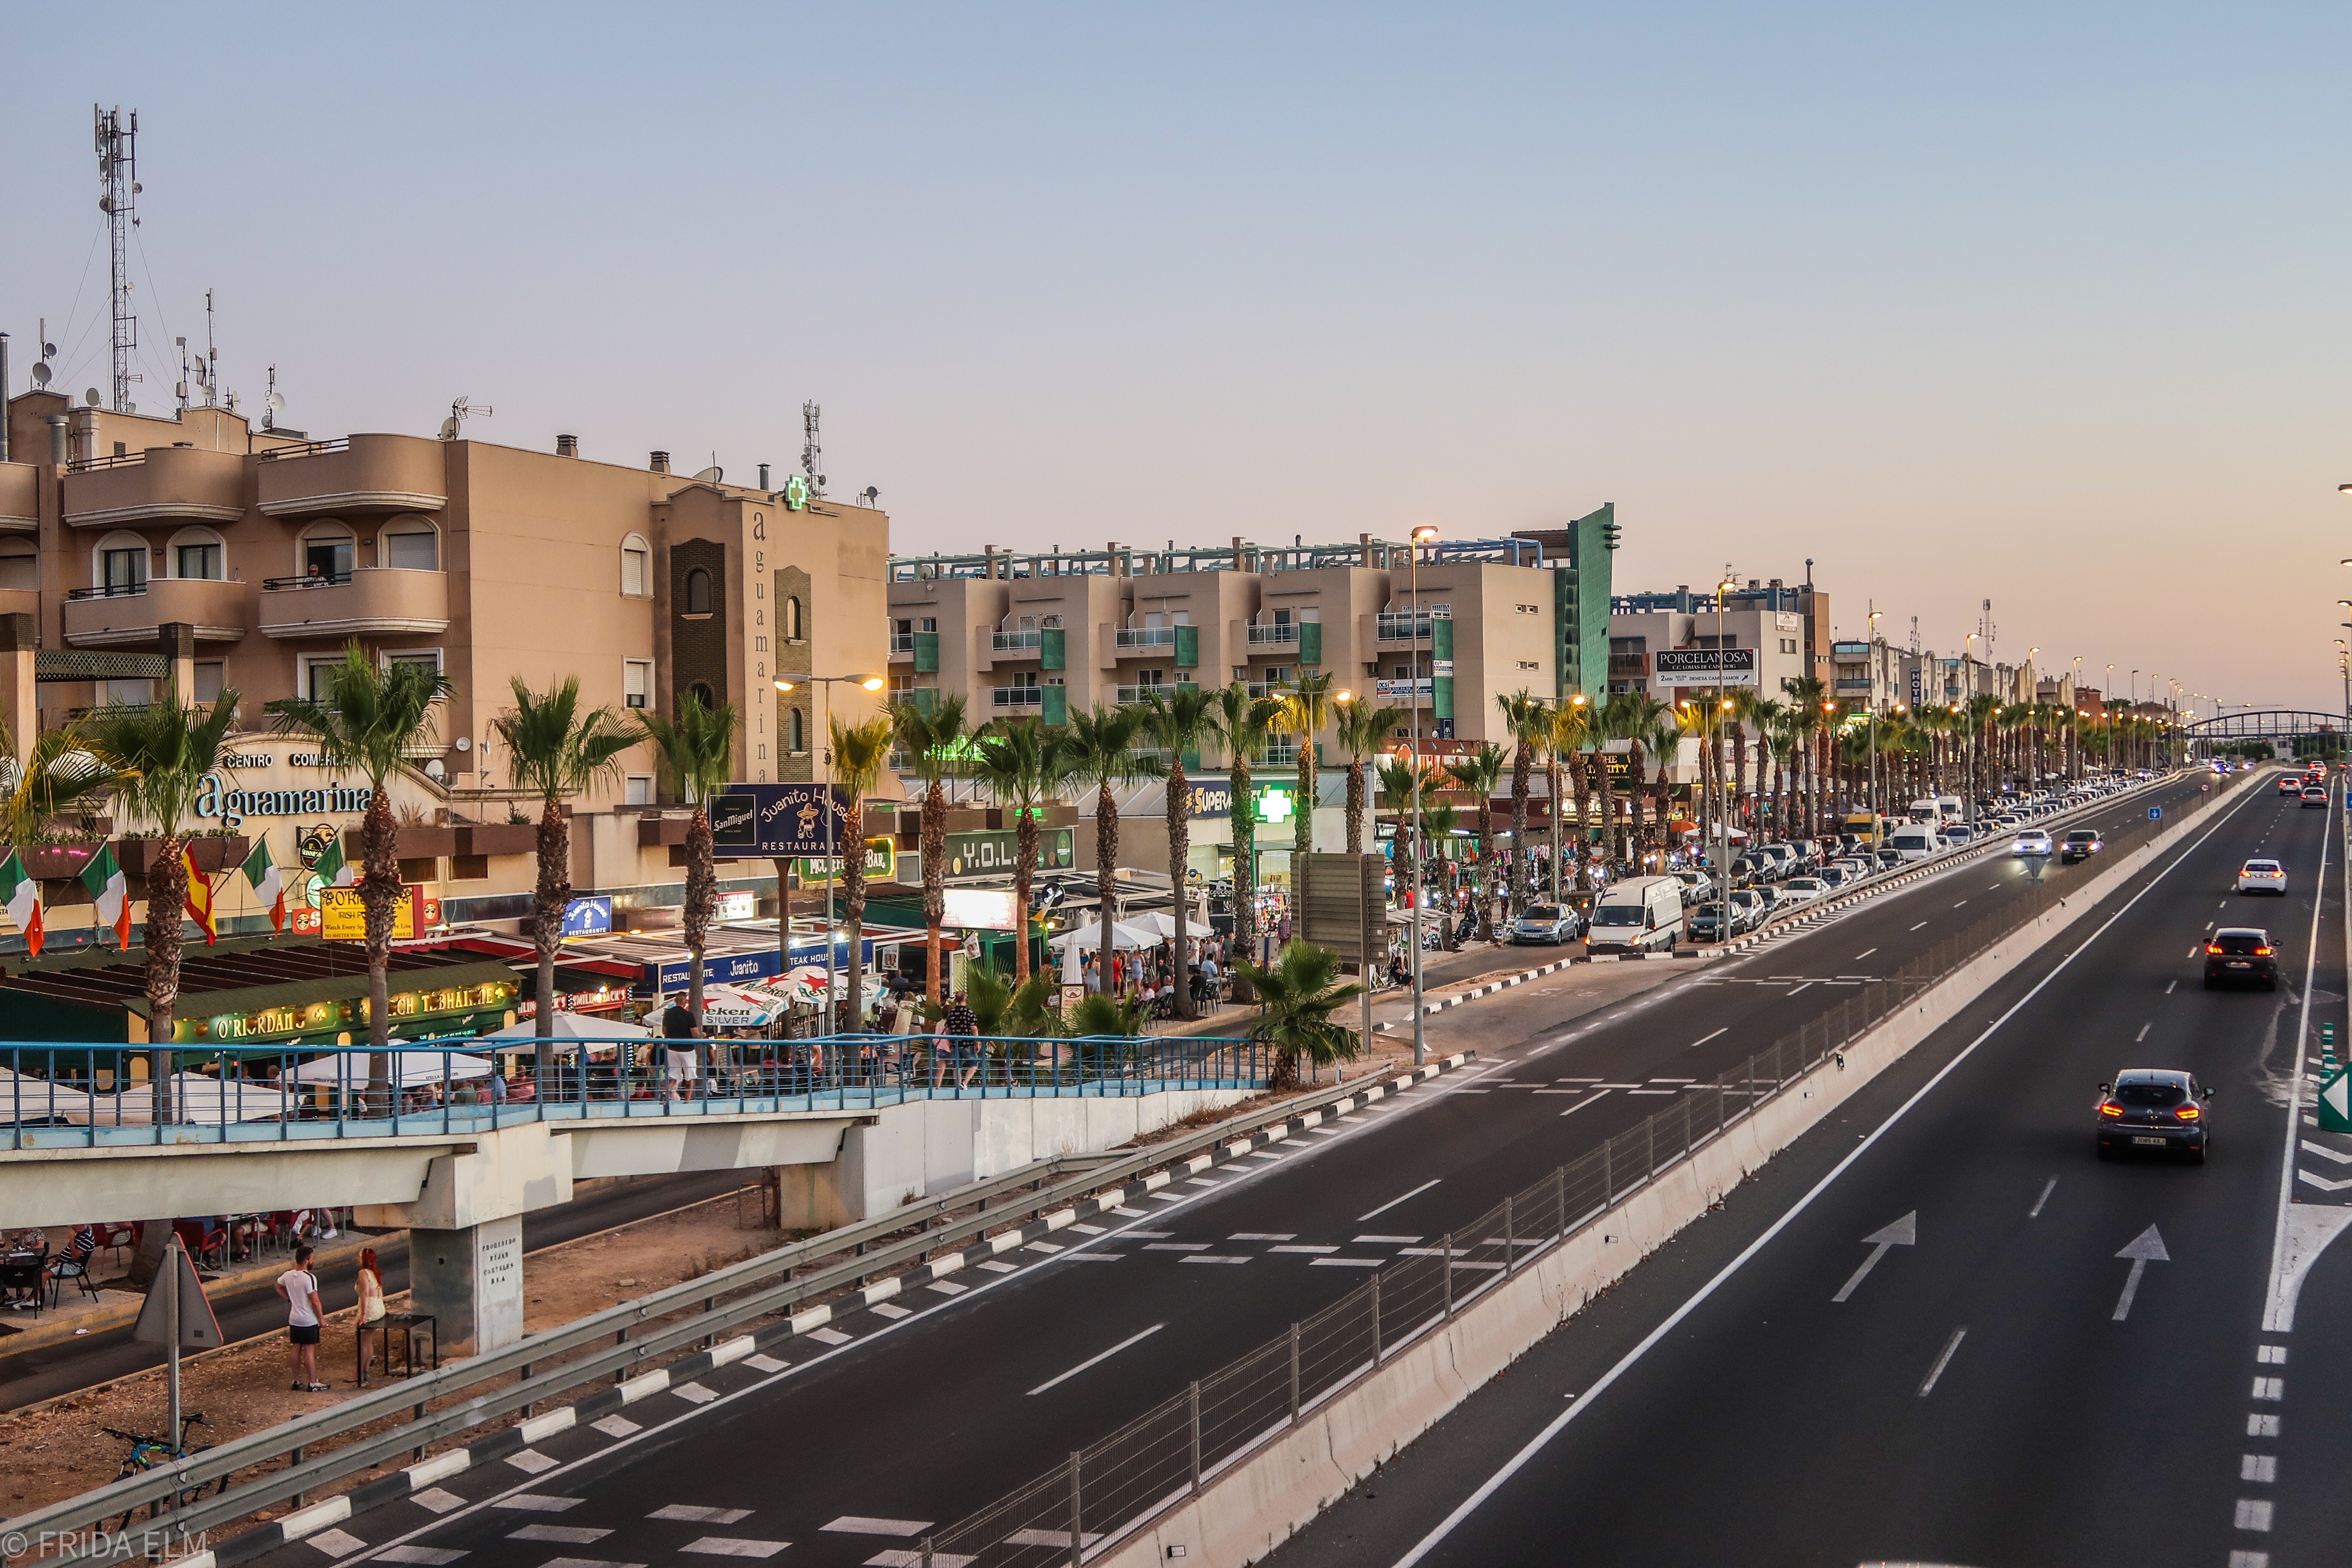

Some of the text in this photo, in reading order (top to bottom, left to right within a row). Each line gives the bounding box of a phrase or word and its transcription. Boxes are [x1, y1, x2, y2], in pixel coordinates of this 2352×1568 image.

[1912, 673, 1920, 706] HOTE
[227, 754, 273, 768] CENTRO
[1605, 755, 1618, 764] HE
[760, 787, 848, 823] Juanito Huse
[568, 899, 607, 921] Juanito House
[568, 927, 606, 936] RESTAURANTE
[730, 959, 758, 977] Juanito
[790, 956, 808, 966] TEAK
